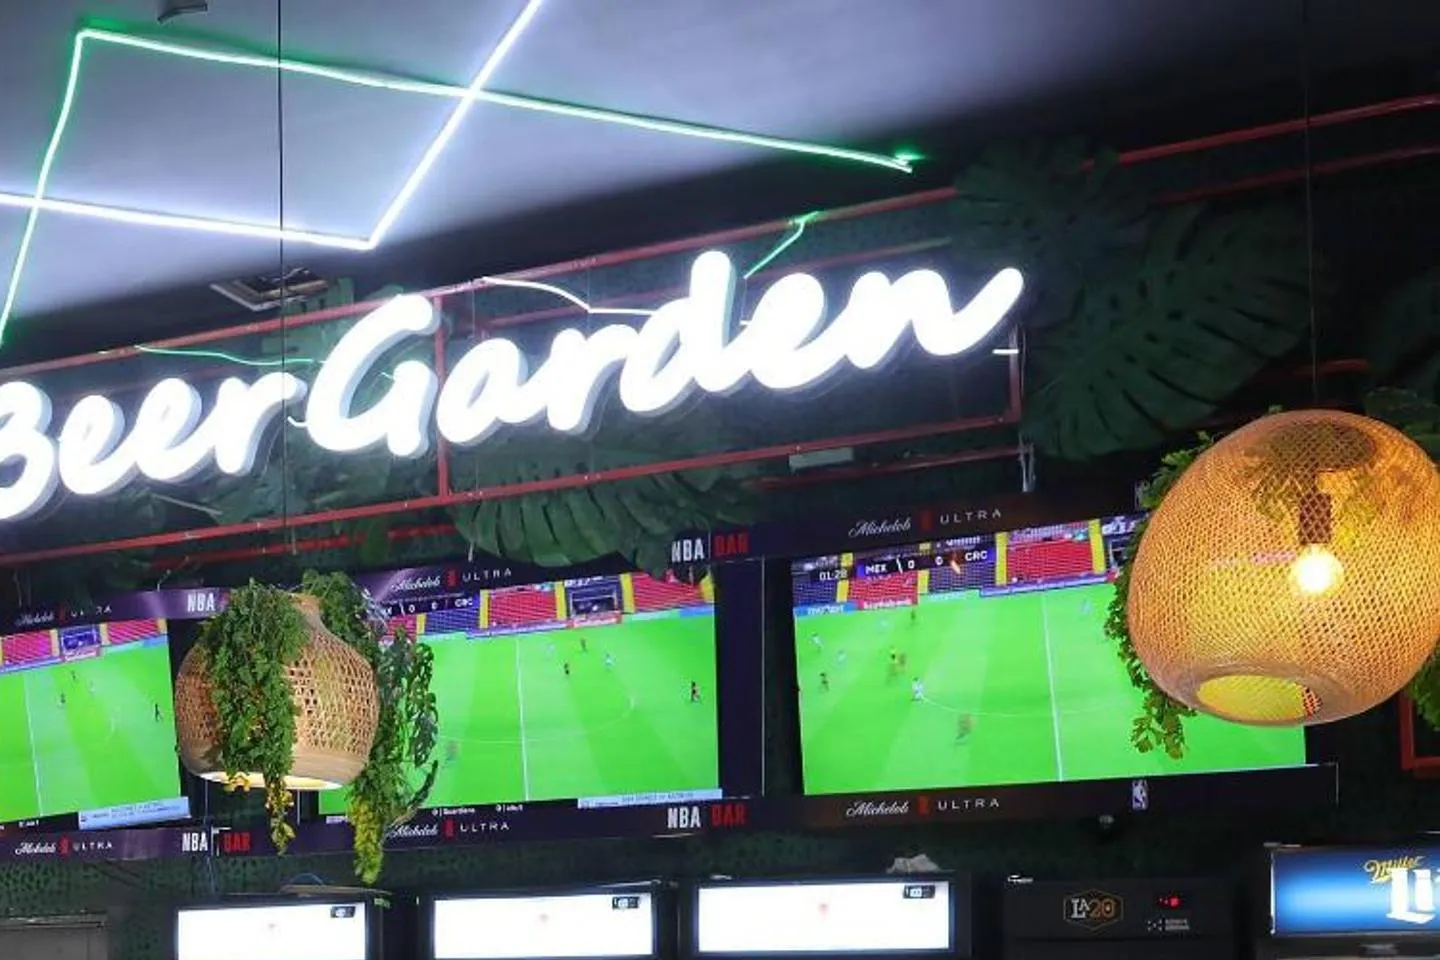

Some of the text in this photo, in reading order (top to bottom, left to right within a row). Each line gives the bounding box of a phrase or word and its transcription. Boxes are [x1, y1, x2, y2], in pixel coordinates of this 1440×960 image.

[849, 509, 1003, 539] Michelob ULTRA
[671, 538, 705, 563] NBA
[462, 568, 513, 583] ULTRA
[187, 592, 216, 613] NBA
[846, 798, 1000, 816] Michelob ULTRA
[459, 820, 510, 833] ULTRA
[667, 806, 701, 830] NBA
[72, 841, 113, 852] ULTRA
[182, 832, 208, 852] NBA
